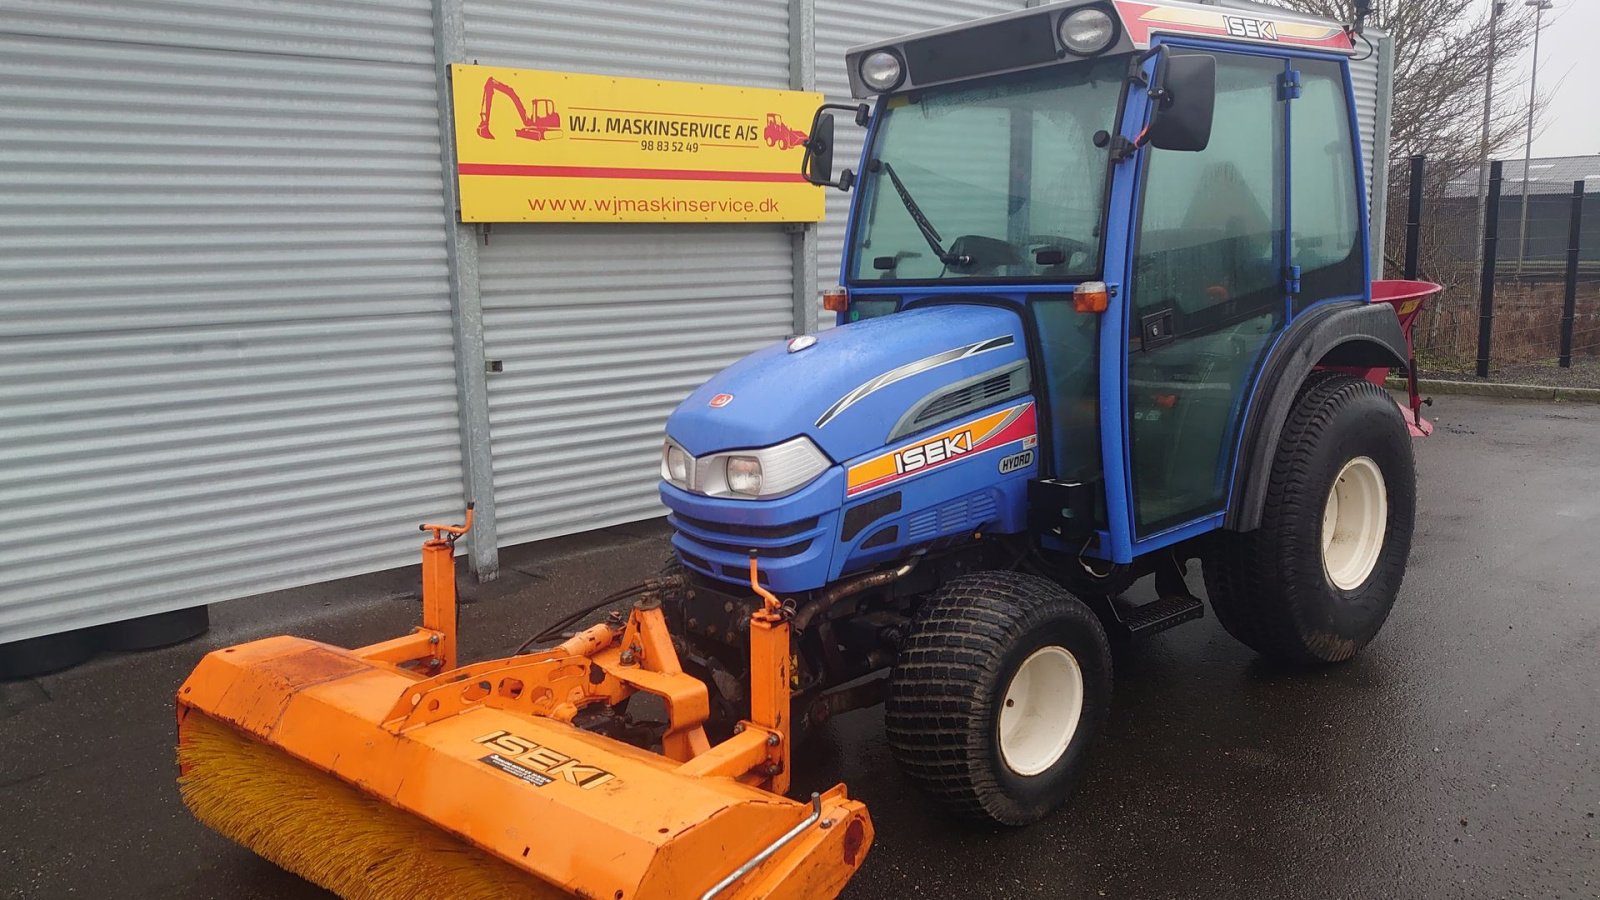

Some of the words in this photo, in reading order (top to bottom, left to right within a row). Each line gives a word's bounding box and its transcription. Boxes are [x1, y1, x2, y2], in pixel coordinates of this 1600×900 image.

[1223, 15, 1279, 40] ISEKI
[569, 115, 601, 133] W.J.
[605, 118, 731, 139] MASKINSERVICE
[735, 125, 758, 141] A/S
[641, 140, 654, 151] 98
[656, 141, 669, 152] 83
[671, 141, 684, 152] 52
[686, 142, 699, 153] 49
[528, 197, 779, 216] www.wjmaskinservice.dk
[894, 430, 973, 475] ISEKI
[1002, 452, 1031, 472] HYDRO
[472, 730, 616, 790] ISEKI
